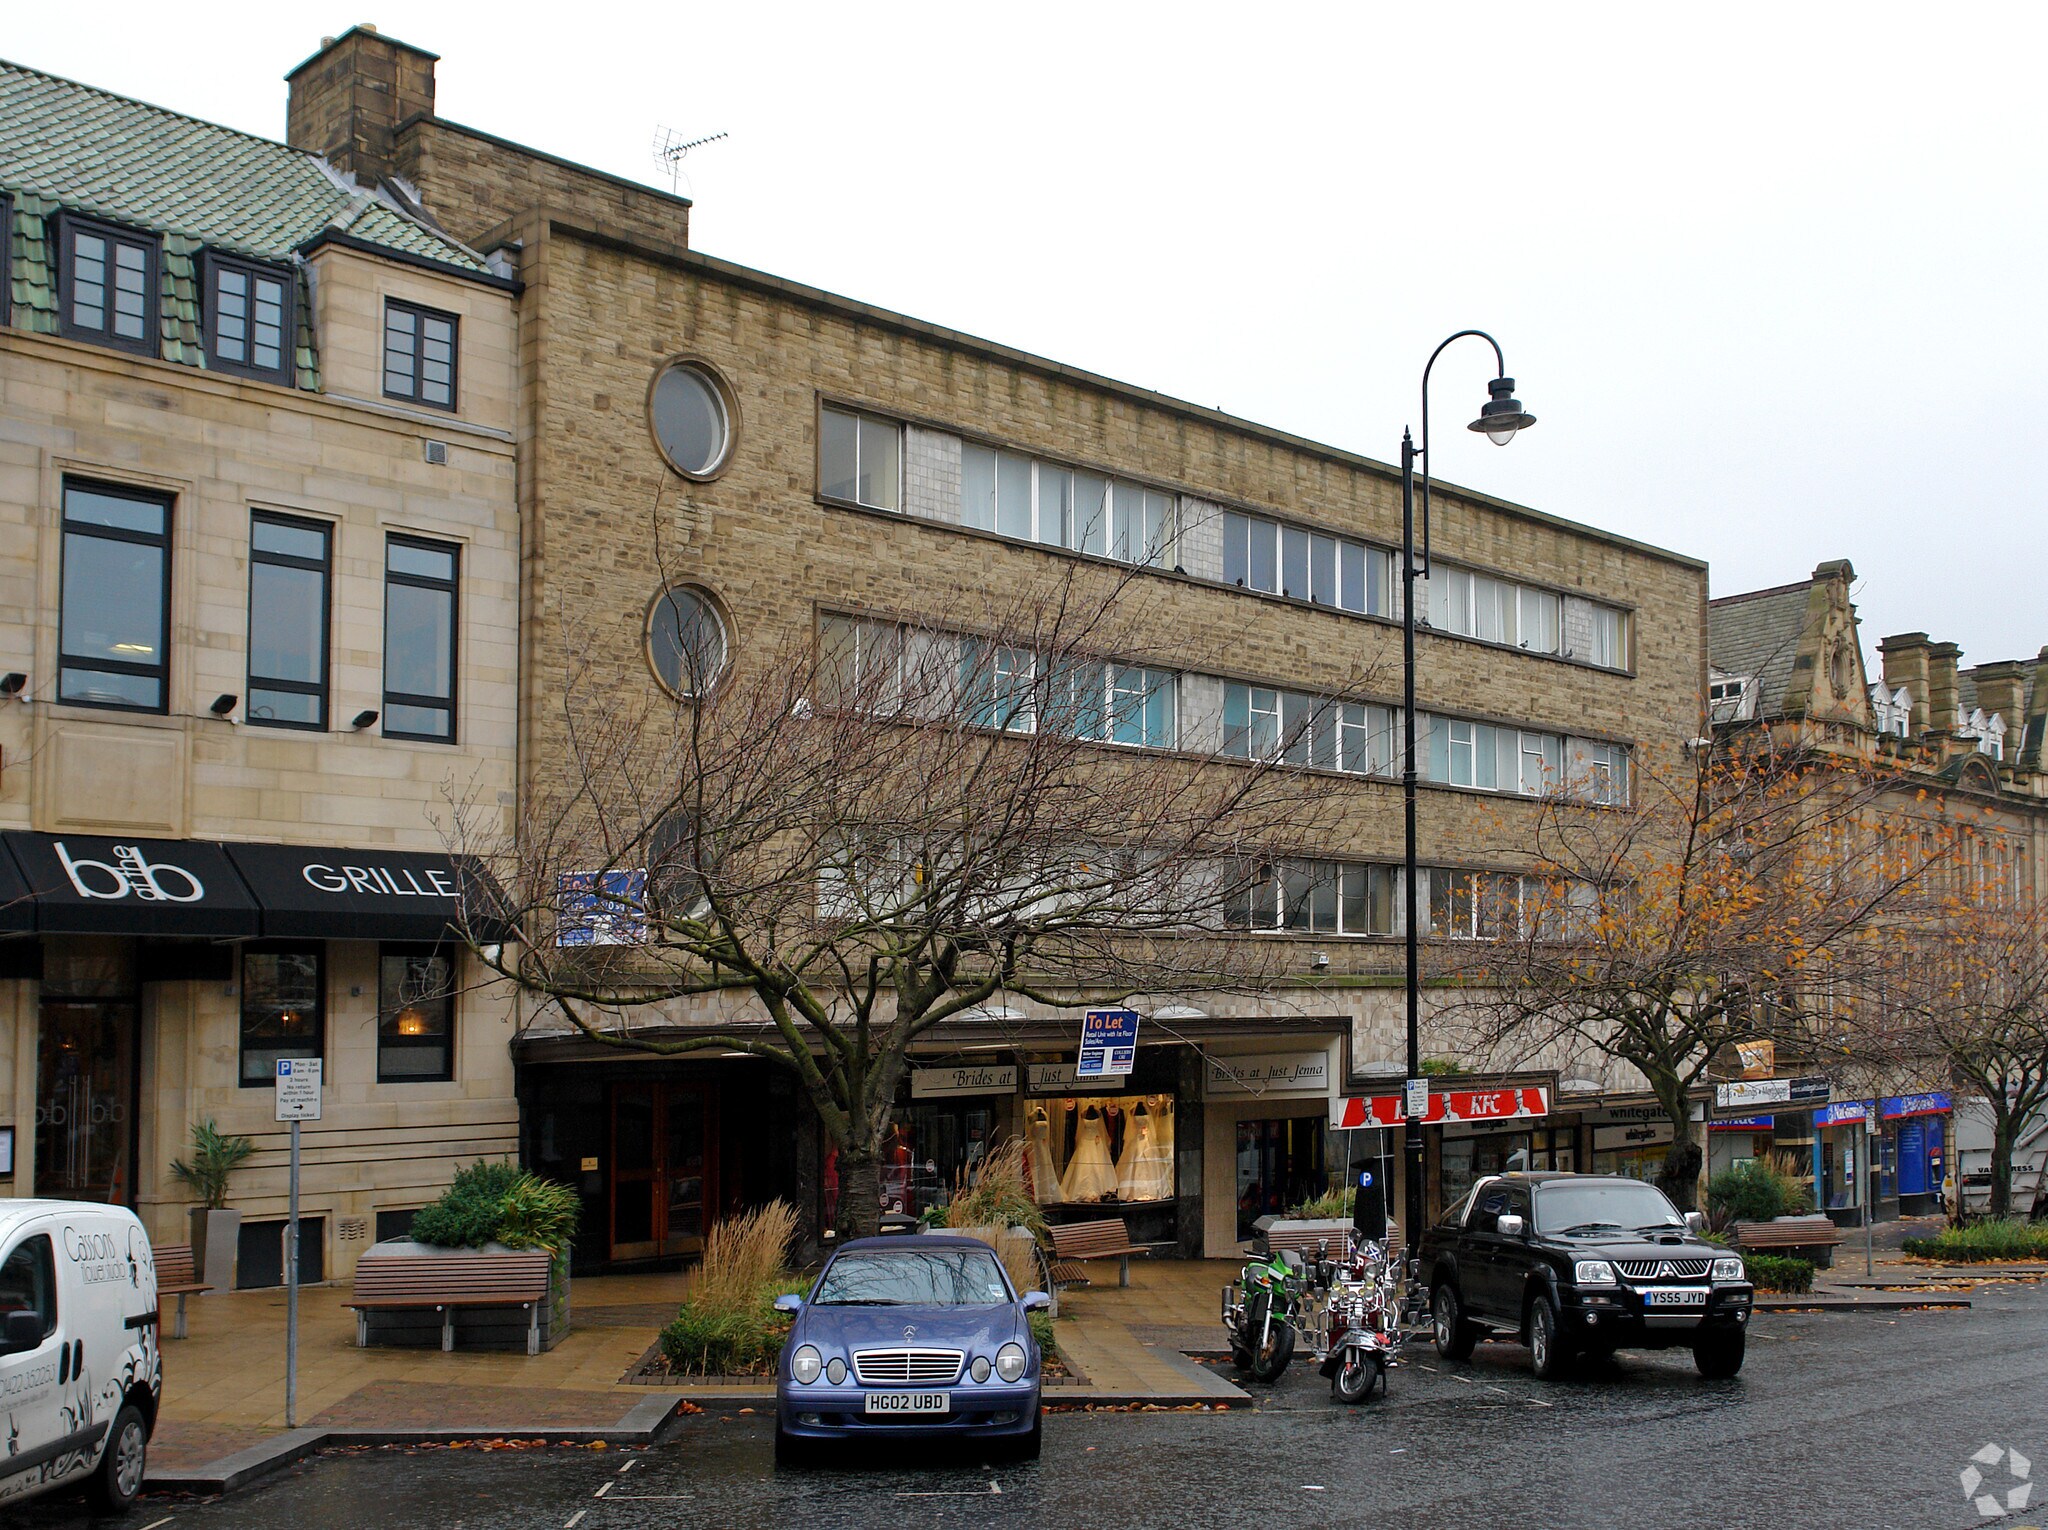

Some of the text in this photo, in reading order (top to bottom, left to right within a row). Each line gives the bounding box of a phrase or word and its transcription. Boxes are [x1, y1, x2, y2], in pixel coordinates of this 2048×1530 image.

[302, 863, 461, 897] GRILLE
[1088, 1014, 1124, 1030] To Let
[952, 1069, 993, 1087] Brides
[999, 1070, 1012, 1085] at
[1032, 1066, 1062, 1091] Just
[1249, 1067, 1260, 1078] at
[1262, 1065, 1288, 1083] Just
[1288, 1064, 1323, 1083] Jenna
[1470, 1094, 1500, 1116] KFC
[1652, 1292, 1705, 1304] YS55 JYD
[870, 1394, 943, 1410] HG02 UBD
